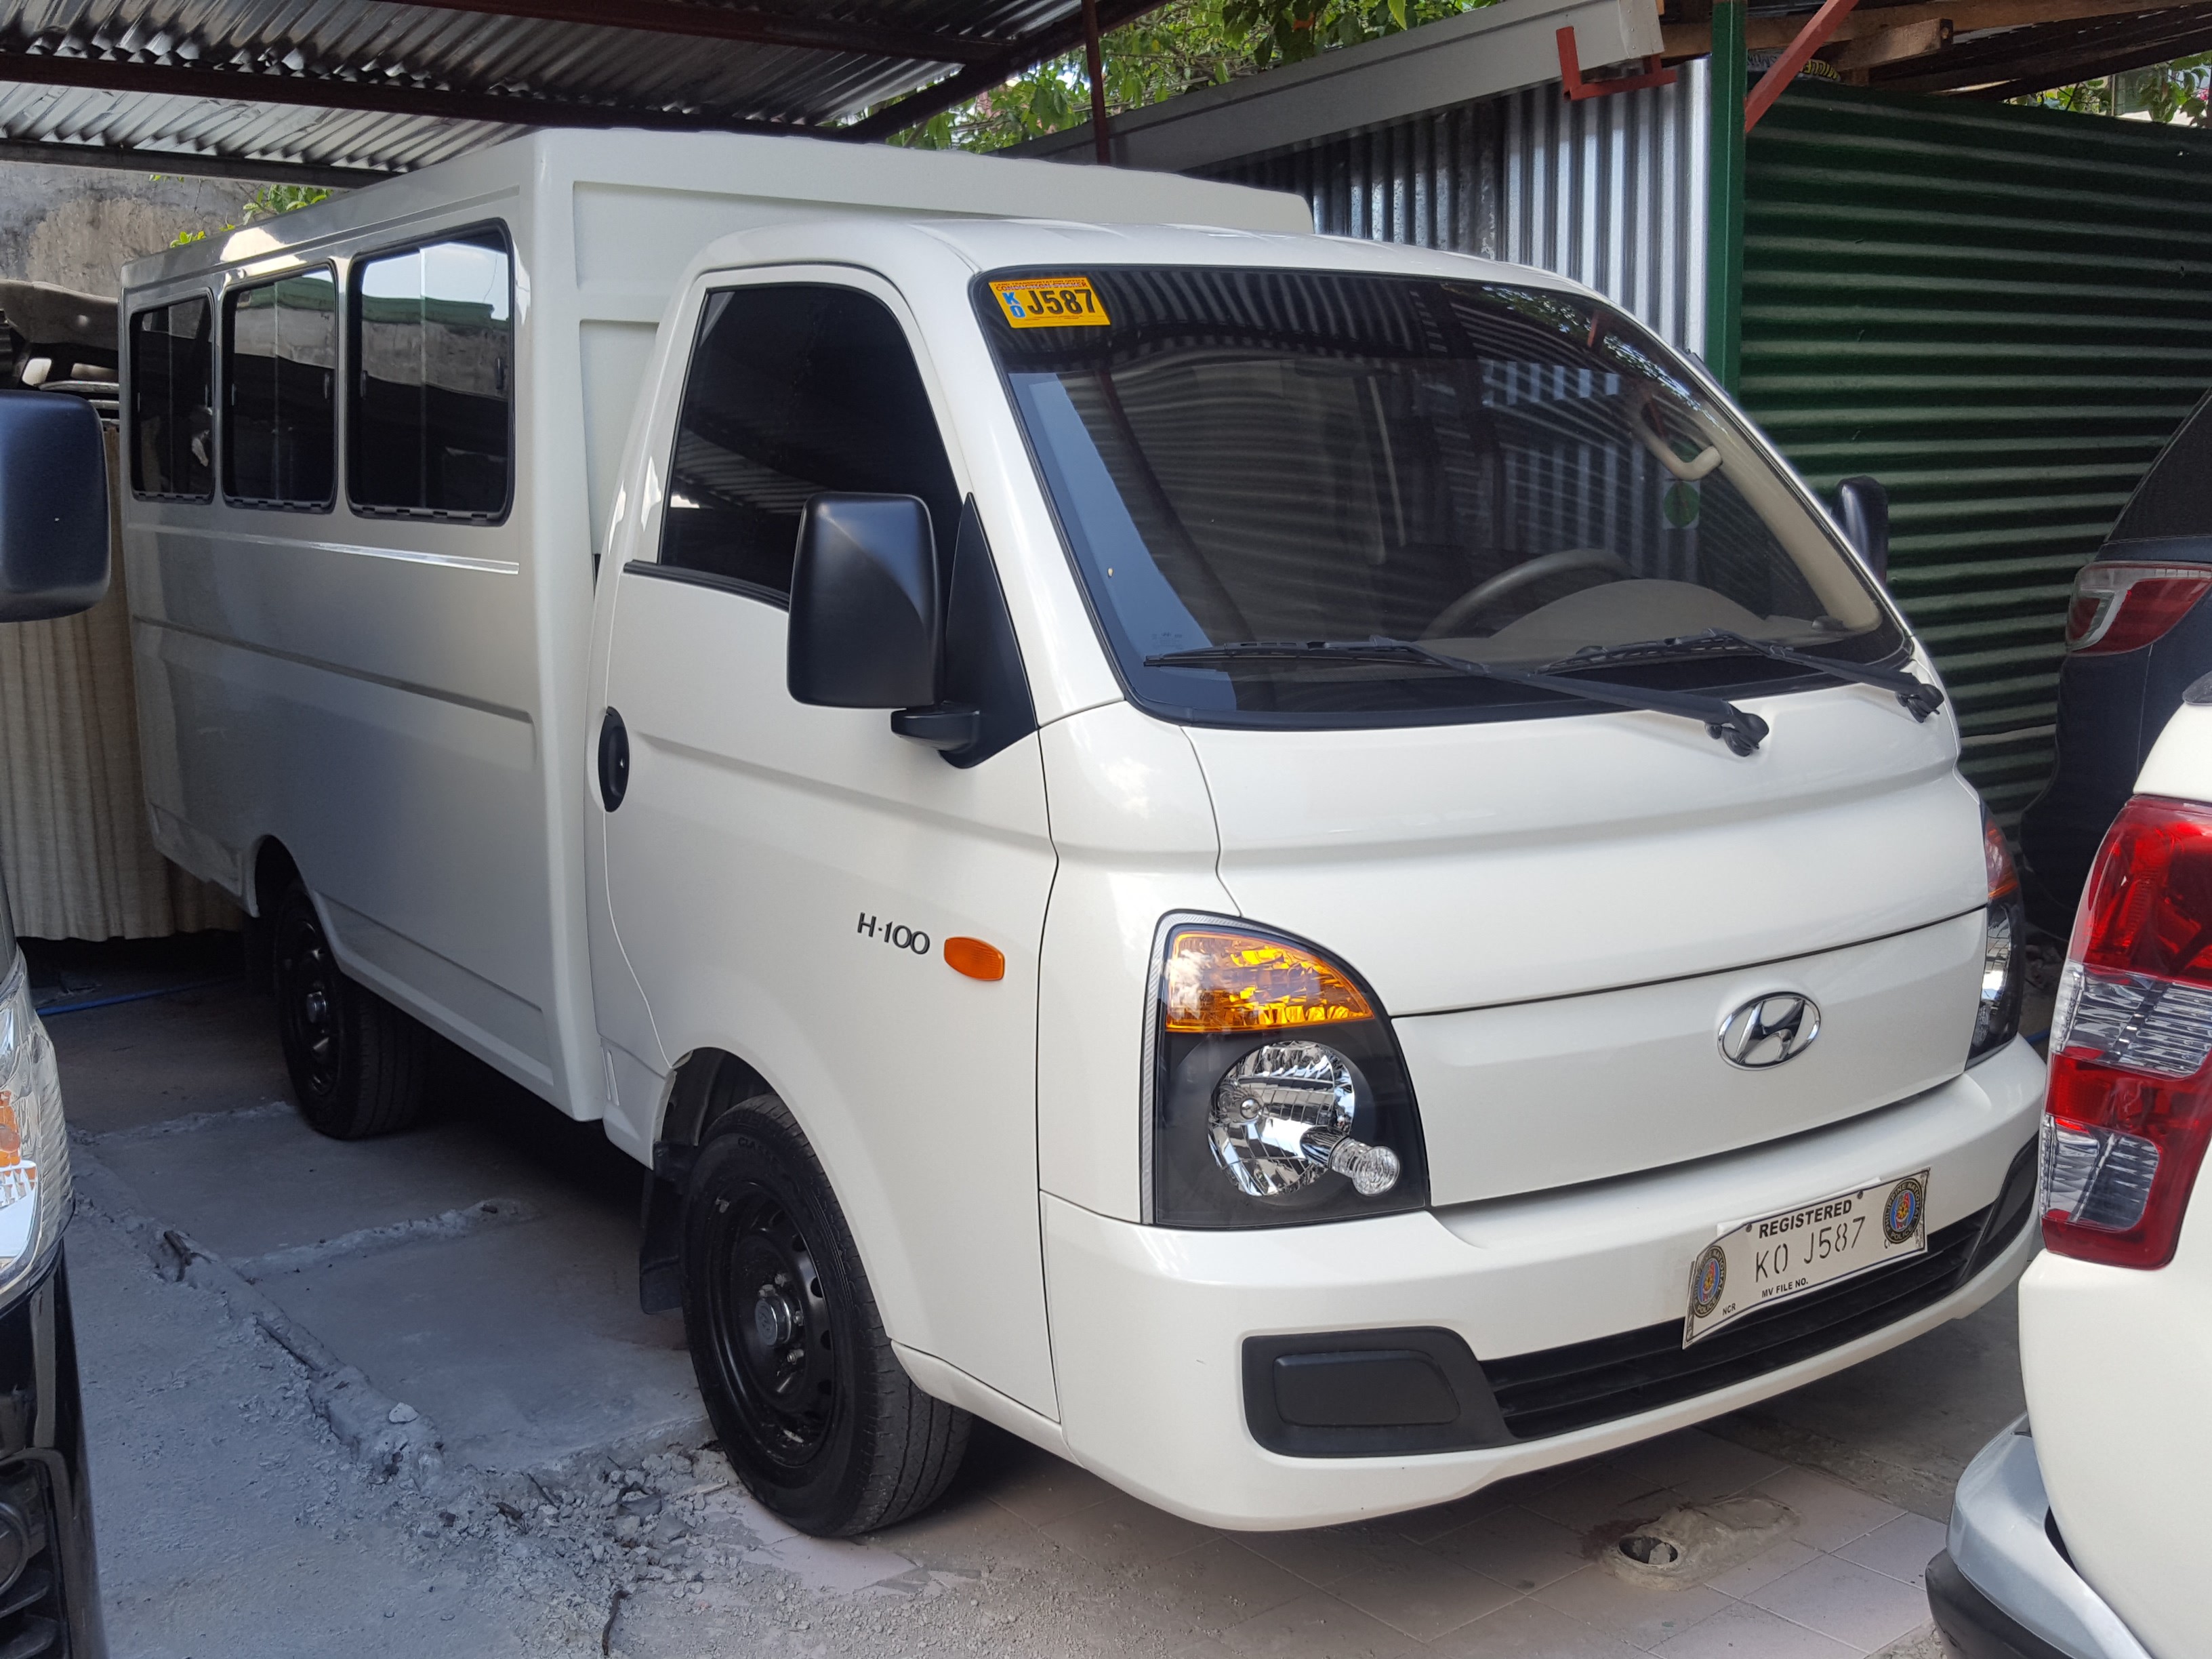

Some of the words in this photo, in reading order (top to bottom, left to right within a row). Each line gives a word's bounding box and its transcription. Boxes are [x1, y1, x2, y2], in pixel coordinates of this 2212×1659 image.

[1027, 289, 1096, 315] J587
[1759, 1200, 1852, 1239] REGISTERED
[1803, 1216, 1866, 1265] J587
[1762, 1287, 1774, 1298] MV
[1776, 1282, 1793, 1294] FILE
[1795, 1277, 1809, 1289] NO.
[1722, 1303, 1736, 1316] NCR
